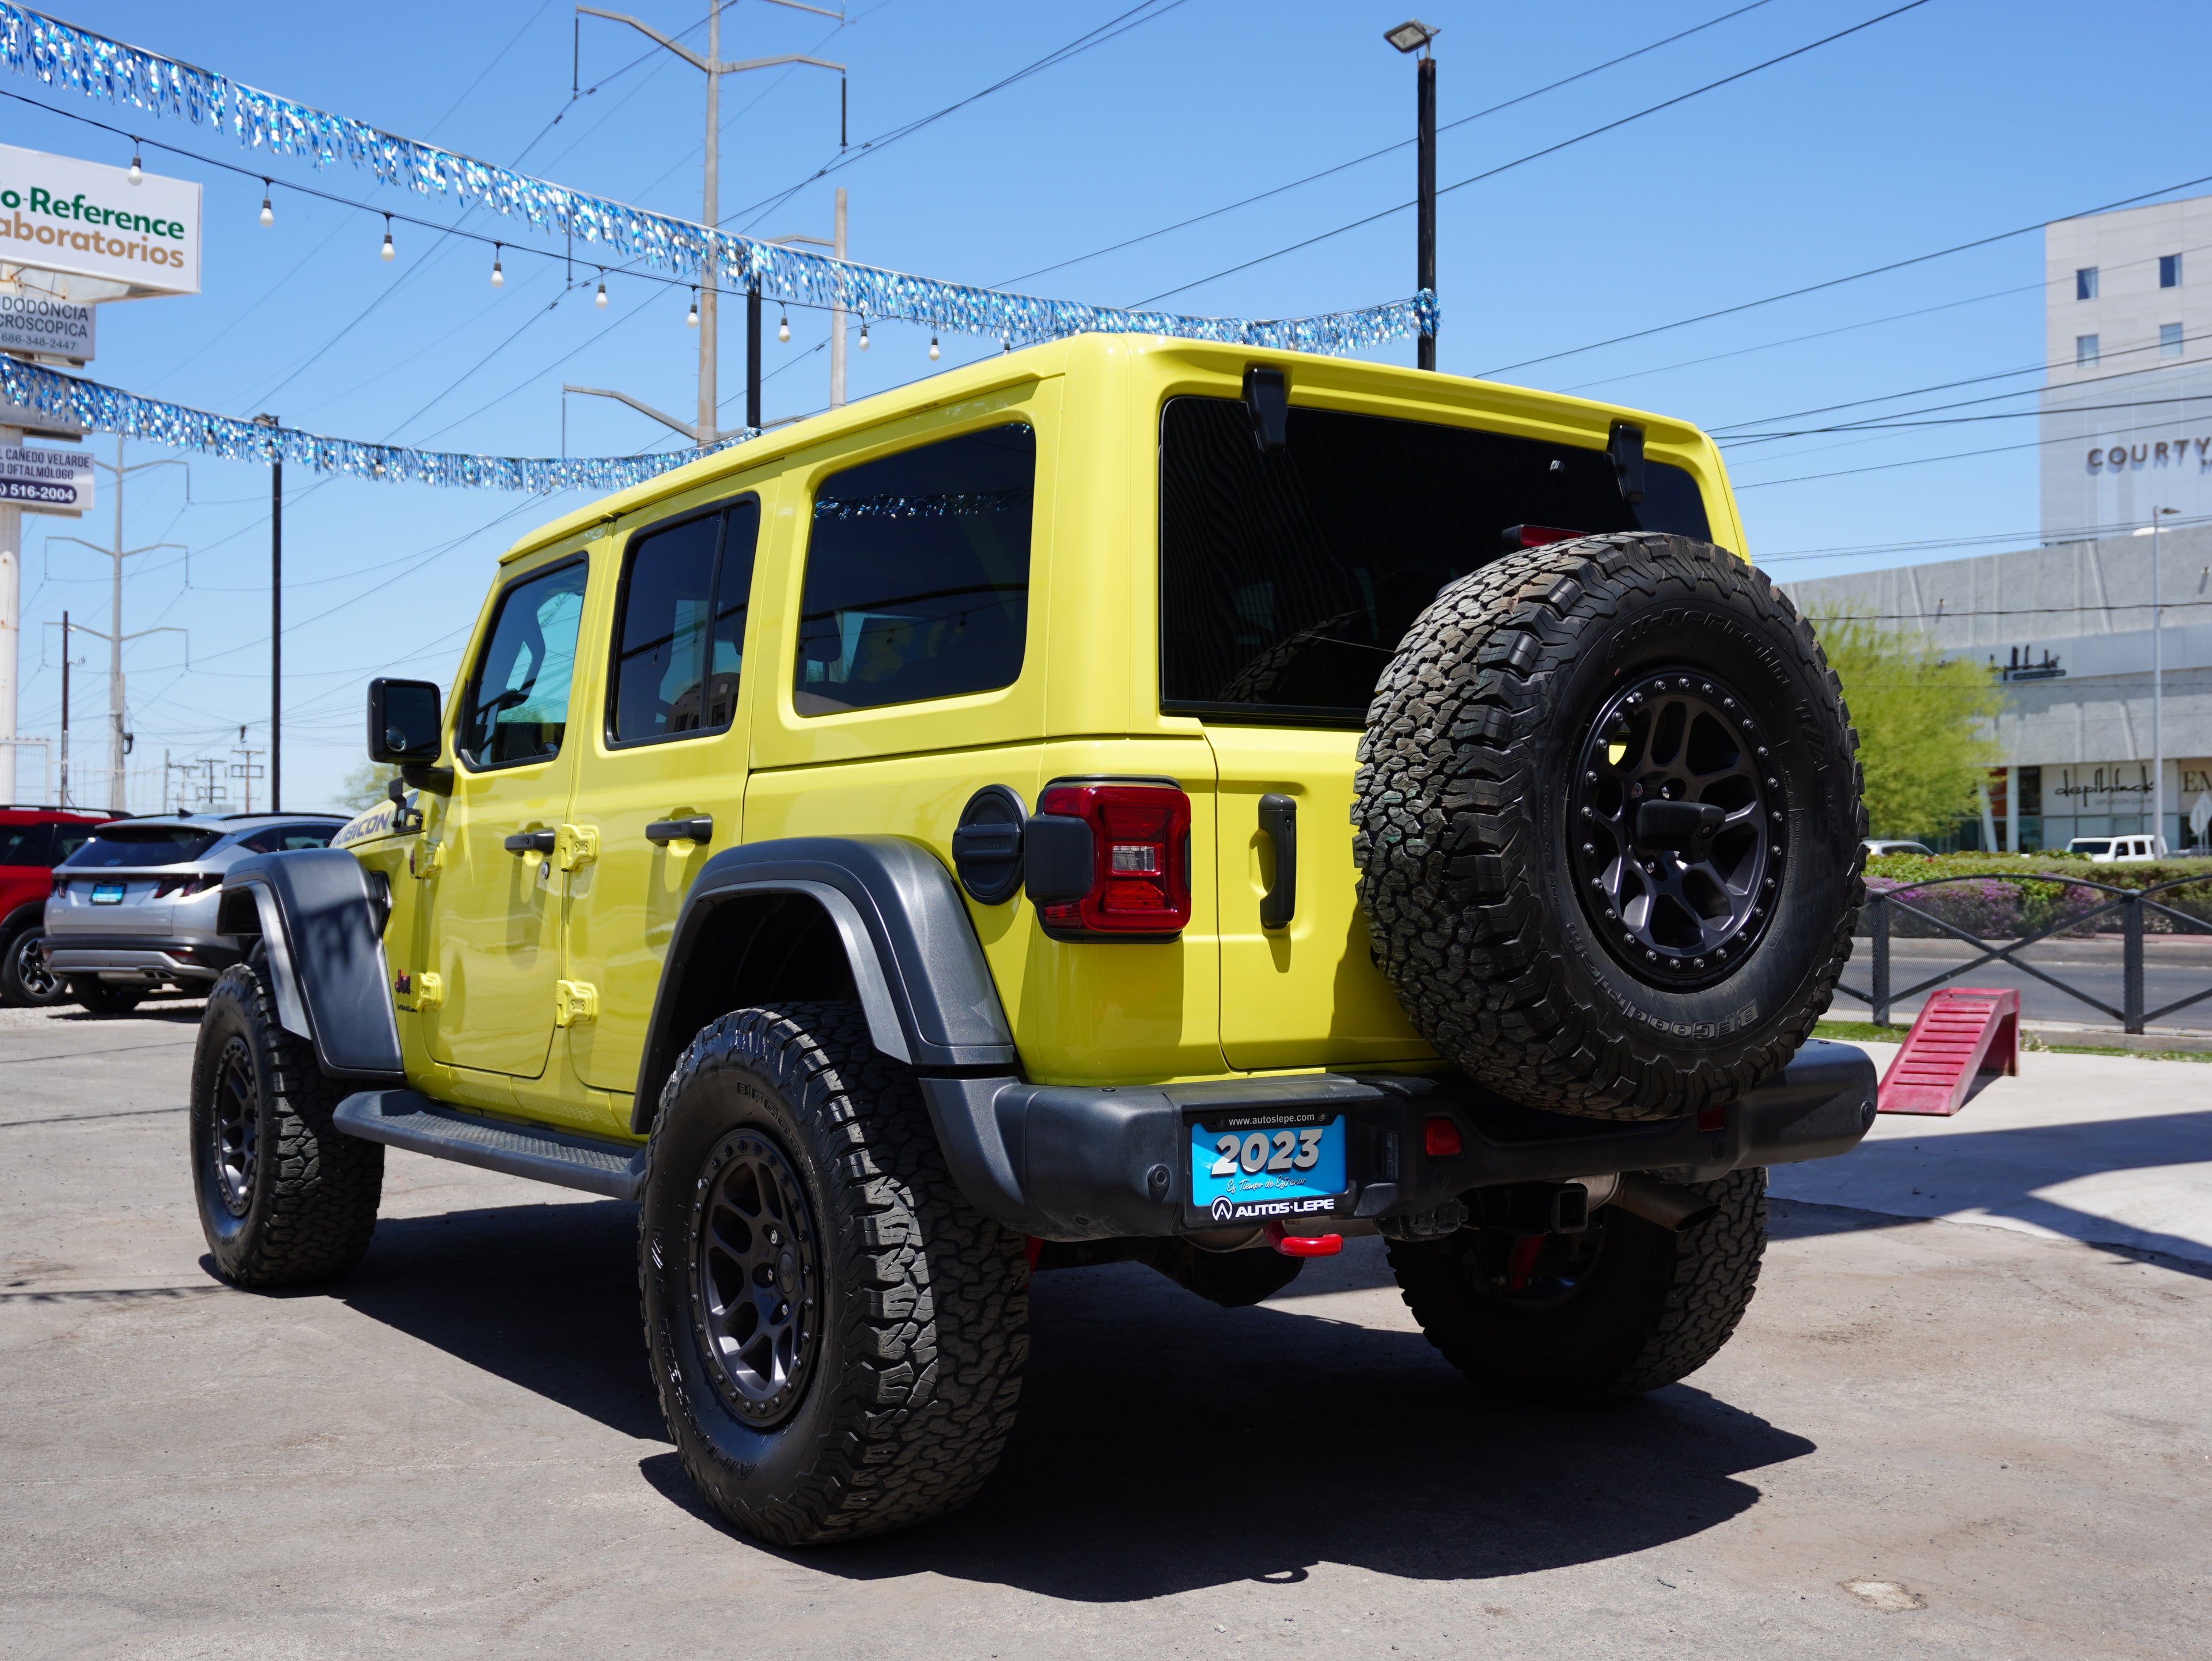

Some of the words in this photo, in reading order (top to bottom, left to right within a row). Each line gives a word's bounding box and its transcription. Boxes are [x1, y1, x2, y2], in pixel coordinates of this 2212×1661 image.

[0, 186, 185, 240] o-Reference
[1, 332, 76, 350] 686-348-2447
[6, 448, 44, 464] CAÑEDO
[47, 453, 90, 468] VELARDE
[2087, 436, 2212, 467] COURTY
[7, 463, 74, 480] OFTALMÓLOGO
[10, 483, 74, 501] 516-2004
[1228, 1114, 1315, 1126] www.autoslepe.com
[1211, 1128, 1324, 1176] 2023
[1226, 1179, 1237, 1194] Es
[1238, 1178, 1264, 1191] Tiempo
[1265, 1179, 1274, 1188] de
[1275, 1175, 1306, 1190] Estrenar
